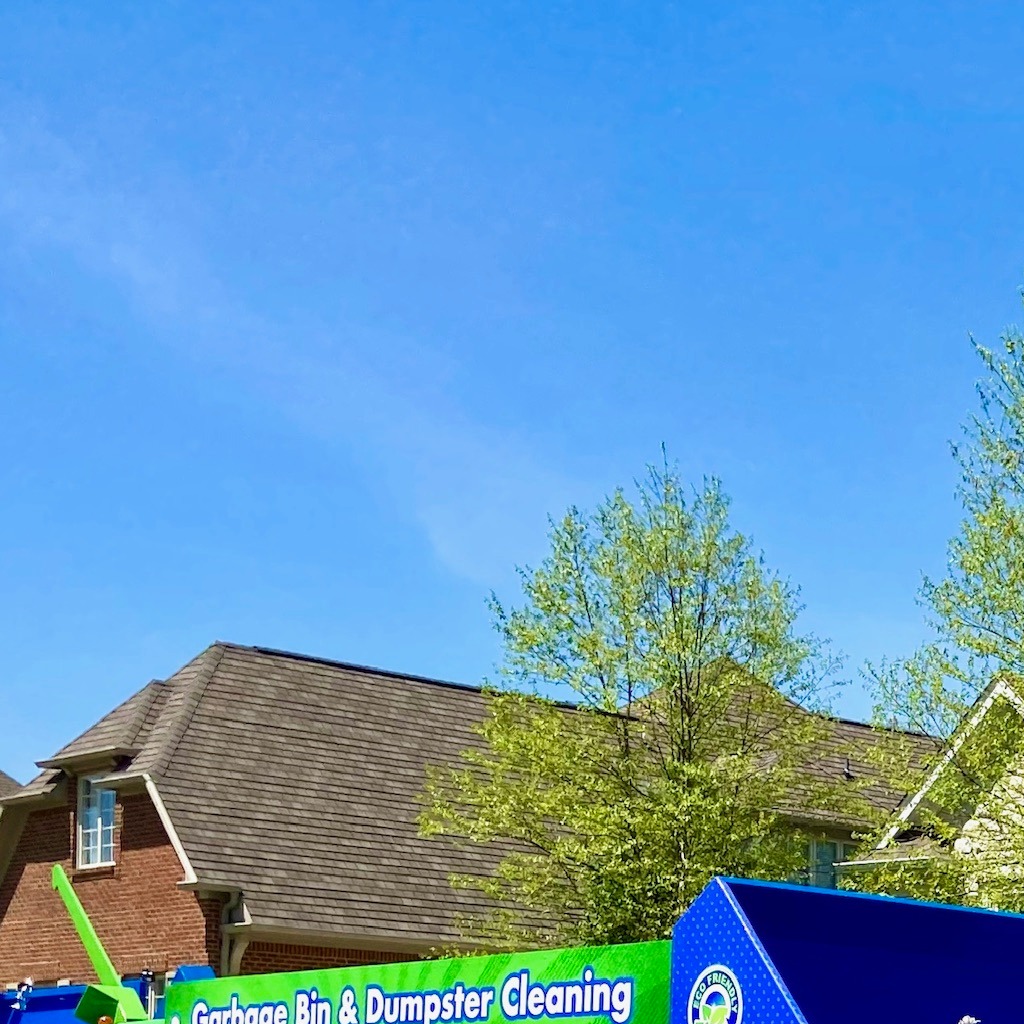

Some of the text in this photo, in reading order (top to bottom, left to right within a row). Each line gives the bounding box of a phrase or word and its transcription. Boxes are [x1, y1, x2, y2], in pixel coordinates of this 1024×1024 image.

[501, 969, 632, 1024] Cleaning
[693, 972, 739, 1013] ECO FRIENDLY
